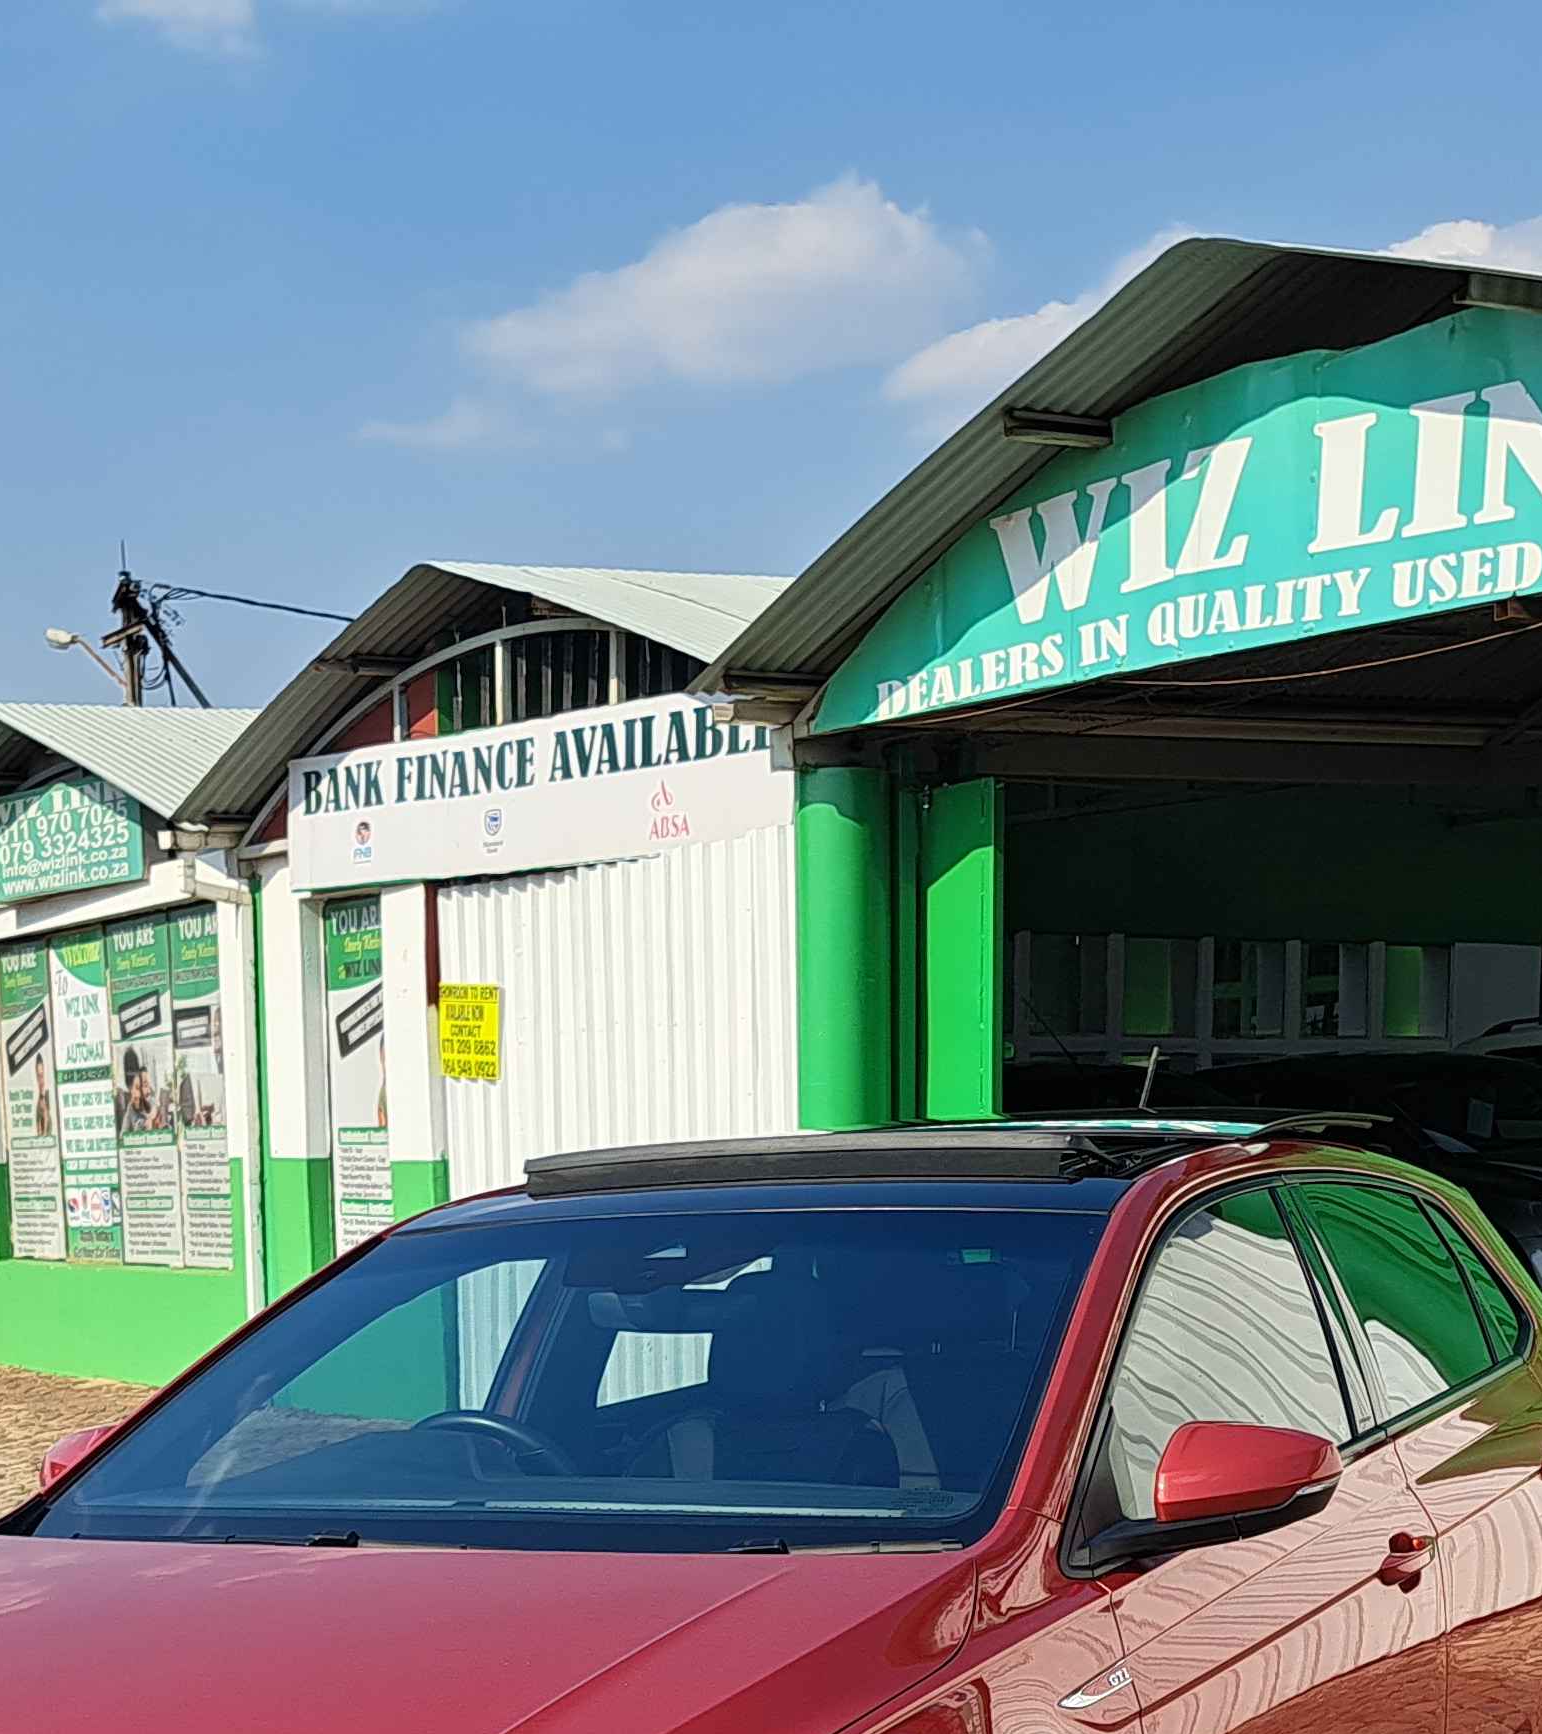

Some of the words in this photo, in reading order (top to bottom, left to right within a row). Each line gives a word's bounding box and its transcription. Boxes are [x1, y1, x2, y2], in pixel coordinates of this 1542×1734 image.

[990, 437, 1252, 625] WIZ
[875, 634, 1064, 721] DEALERS
[1079, 615, 1130, 666] IN
[1147, 569, 1371, 647] QUALITY
[1393, 541, 1542, 608] USED
[301, 759, 384, 815] BANK
[395, 737, 535, 803] FINANCE
[36, 811, 71, 837] 970
[78, 801, 128, 829] 7025
[649, 815, 690, 840] ABSA
[0, 841, 34, 865] 079
[41, 821, 130, 858] 3324325
[3, 863, 129, 896] www.wizlink.co.za
[178, 915, 202, 940] YOU
[331, 908, 357, 936] YOU
[361, 904, 381, 931] AR
[113, 930, 134, 952] YOU
[1108, 1667, 1130, 1686] GTI
